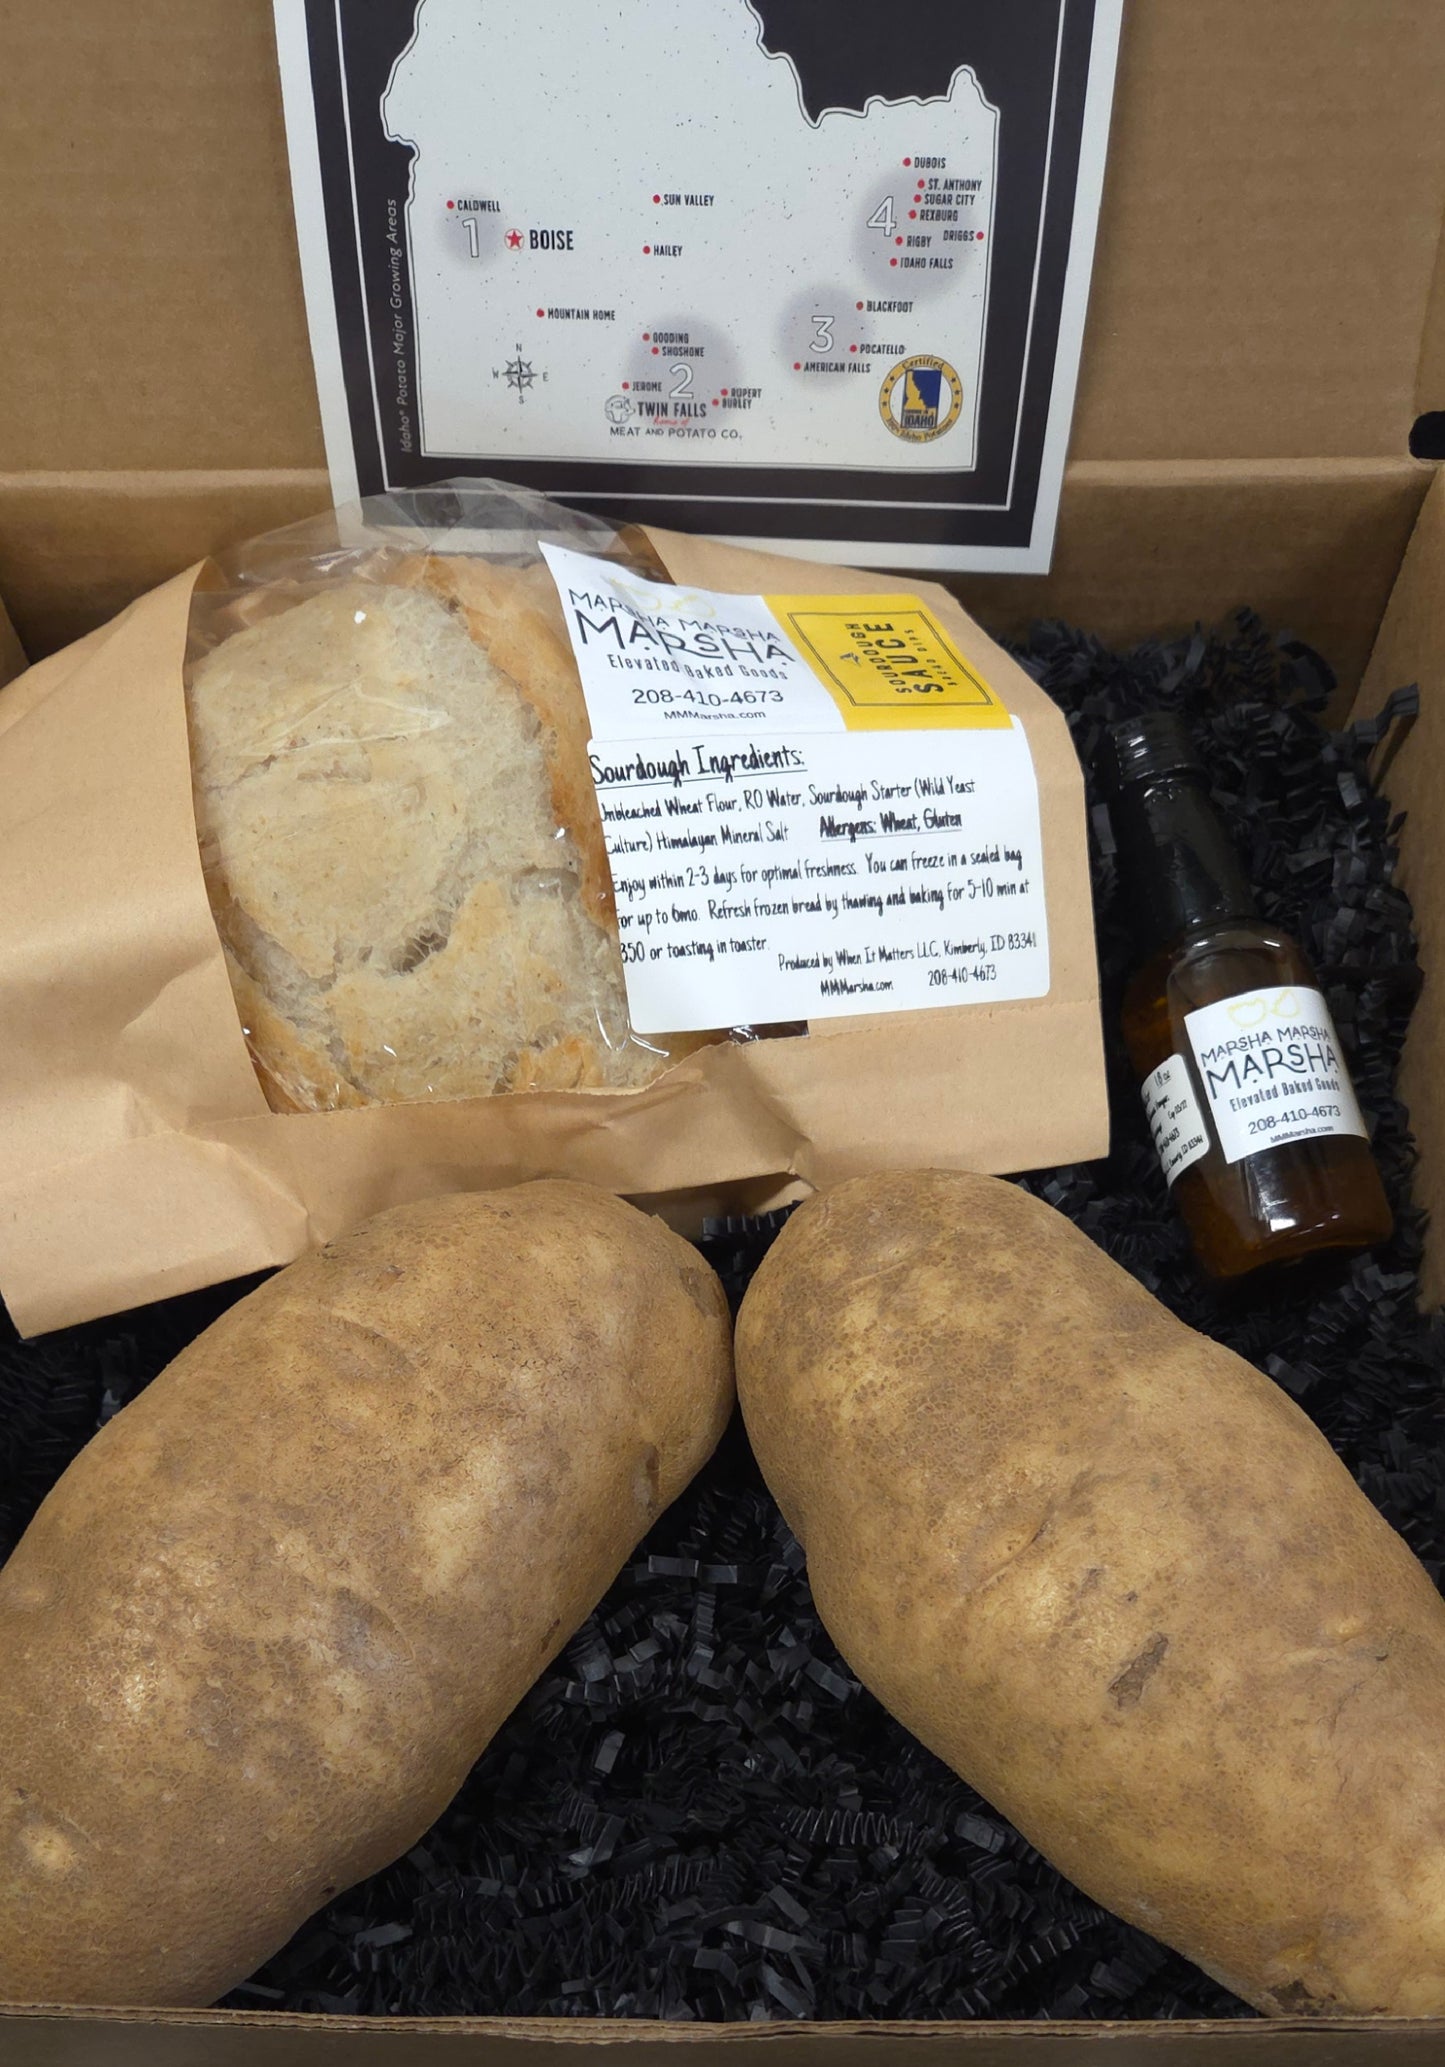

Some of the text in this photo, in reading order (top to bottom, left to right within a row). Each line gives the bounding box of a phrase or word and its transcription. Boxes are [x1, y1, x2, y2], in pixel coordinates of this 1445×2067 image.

[913, 157, 947, 169] DUBOIS
[927, 178, 982, 192] ST. ANTHONY
[457, 199, 501, 213] CALDWELL
[663, 193, 715, 207] SUN VALLEY
[924, 193, 976, 206] SUGAR CITY
[386, 199, 399, 244] Areas
[866, 195, 897, 238] 4
[919, 208, 958, 222] REXBURG
[461, 217, 480, 258] 1
[529, 229, 574, 250] BOISE
[906, 235, 932, 248] RIGBY
[943, 229, 975, 242] DRIGGS
[653, 245, 683, 257] HAILEY
[900, 257, 954, 270] IDAHO FALLS
[388, 247, 402, 309] Growing
[547, 308, 616, 321] MOUNTAIN HOME
[866, 300, 914, 313] BLACKFOOT
[392, 313, 407, 355] Major
[809, 315, 835, 353] 3
[515, 343, 522, 352] N
[661, 346, 705, 358] SHOSHONE
[859, 343, 906, 355] POCATELLO
[803, 362, 871, 374] AMERICAN FALLS
[902, 357, 944, 370] Certified
[396, 359, 408, 406] Potato
[632, 381, 662, 392] JEROME
[669, 362, 694, 400] 2
[722, 398, 753, 409] BURLEY
[731, 388, 762, 399] RUPERT
[637, 401, 707, 418] TWIN FALLS
[609, 426, 743, 440] MEAT AND POTATO CO.
[568, 588, 782, 644] MARSHA MARSHA
[574, 608, 796, 667] MARSHA
[606, 653, 789, 681] Elevated Baked Goods
[845, 623, 913, 693] SOURDOUGH
[863, 623, 944, 694] SAUCE
[631, 688, 785, 708] 208-410-4673
[663, 710, 767, 722] MMMarsha.com
[589, 743, 805, 788] Sourdough Ingredients:
[664, 795, 703, 817] Wheat
[743, 789, 763, 810] RO
[808, 784, 868, 811] Sourdough
[871, 779, 912, 801] Starter
[914, 776, 946, 800] (Wild
[949, 775, 976, 795] Yeast
[656, 828, 718, 854] Himalayan
[720, 822, 764, 845] Mineral
[765, 820, 790, 842] Salt
[819, 815, 877, 843] Allergens:
[880, 811, 921, 833] Wheat,
[923, 808, 963, 829] Gluten
[649, 869, 685, 890] within
[686, 865, 710, 887] 2-3
[713, 866, 738, 892] days
[740, 863, 758, 883] for
[761, 860, 802, 890] optimal
[865, 851, 887, 874] You
[890, 858, 908, 872] can
[911, 850, 945, 870] freeze
[947, 852, 958, 868] in
[960, 854, 967, 866] a
[970, 844, 1000, 864] sealed
[1003, 845, 1022, 871] bag
[637, 914, 652, 934] up
[656, 908, 668, 924] to
[707, 898, 751, 920] Refresh
[753, 897, 789, 917] frozen
[793, 893, 822, 914] bread
[824, 892, 839, 919] by
[841, 891, 884, 917] thawing
[886, 886, 906, 906] and
[908, 884, 945, 911] baking
[947, 882, 965, 901] for
[967, 877, 993, 900] 5-10
[996, 882, 1017, 897] min
[1020, 878, 1030, 894] at
[620, 941, 645, 964] 350
[649, 945, 663, 961] or
[667, 939, 715, 962] toasting
[716, 939, 728, 954] in
[778, 952, 820, 971] Produced
[822, 952, 834, 974] by
[835, 948, 862, 967] When
[864, 946, 876, 964] It
[878, 945, 915, 963] Matters
[990, 934, 1005, 952] ID
[1007, 931, 1037, 950] 83341
[928, 964, 997, 986] 208-410-4673
[1200, 1025, 1332, 1067] MARSHA MARSHA
[1206, 1043, 1340, 1100] MARSHA
[1229, 1077, 1341, 1112] Elevated Baked Goods
[1248, 1105, 1342, 1135] 208-410-4673
